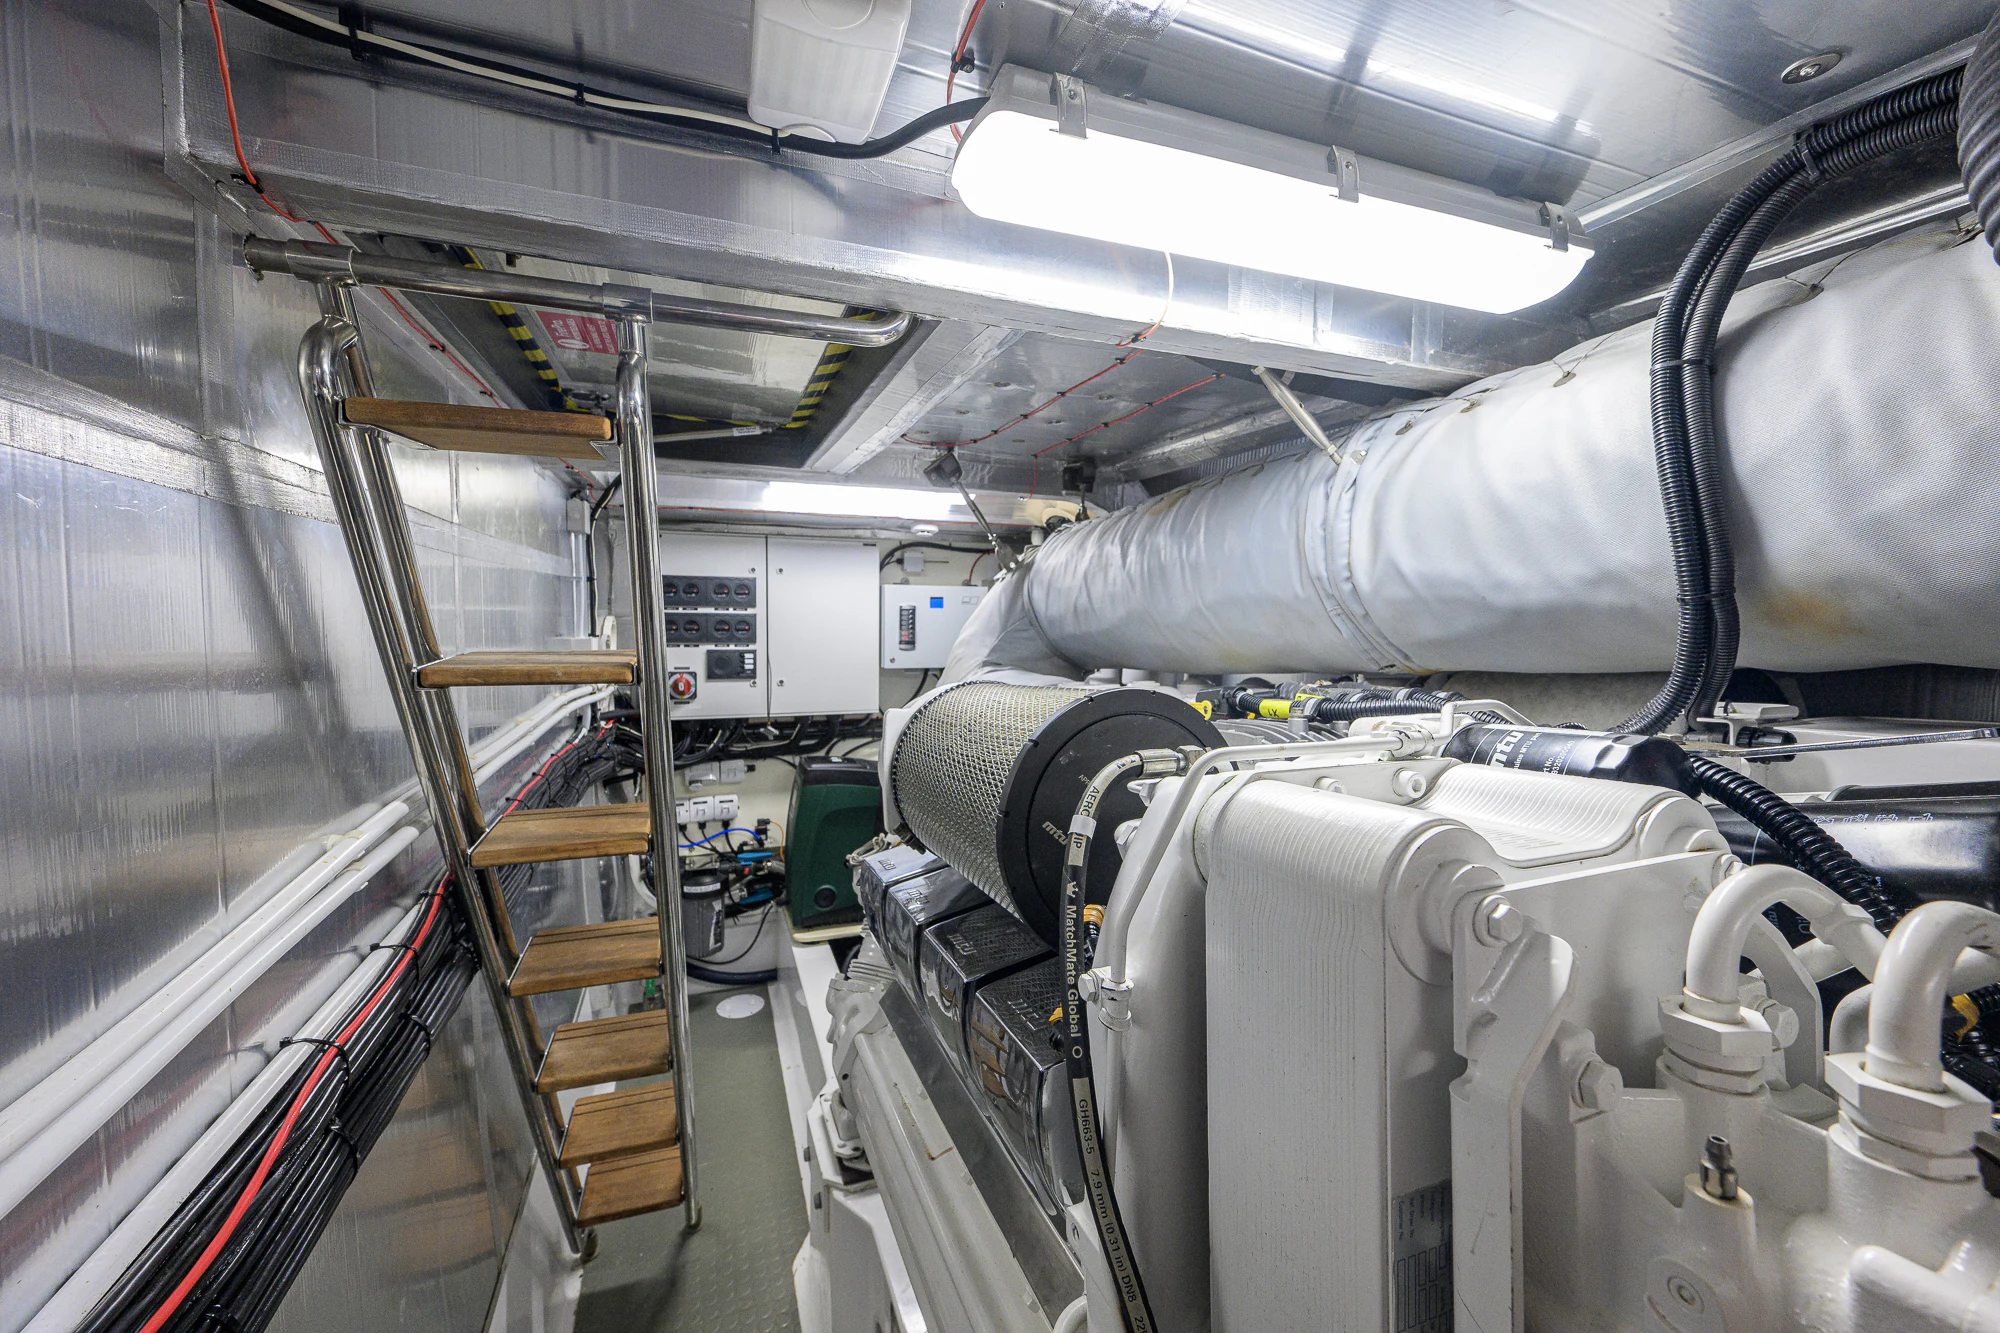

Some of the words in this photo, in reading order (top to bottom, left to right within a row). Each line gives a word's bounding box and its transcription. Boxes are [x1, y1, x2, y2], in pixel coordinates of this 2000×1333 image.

[1042, 821, 1068, 845] mtu
[1066, 905, 1077, 985] MatchMate
[1067, 990, 1082, 1037] Global
[1079, 1098, 1095, 1155] GH663-5
[1091, 1169, 1102, 1188] 7.9
[1095, 1192, 1108, 1219] mm
[1114, 1254, 1128, 1273] in)
[1122, 1275, 1137, 1303] DN8
